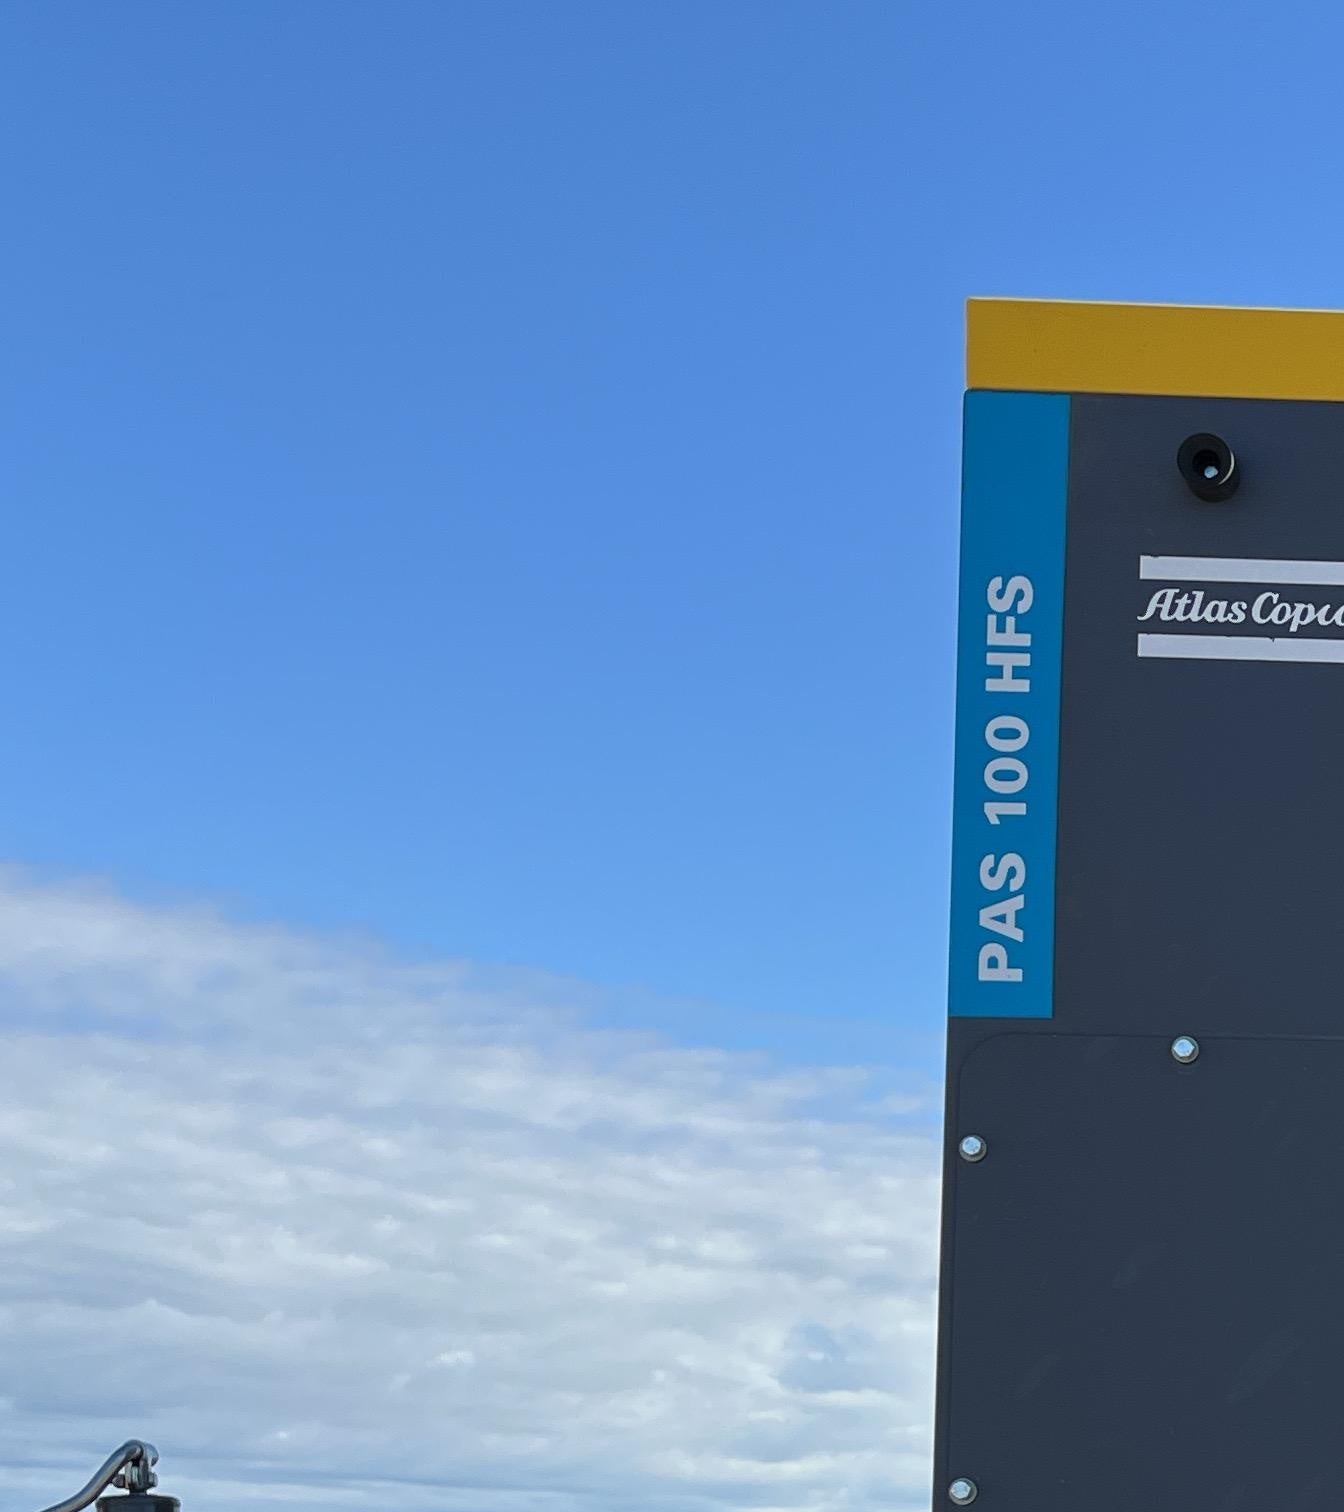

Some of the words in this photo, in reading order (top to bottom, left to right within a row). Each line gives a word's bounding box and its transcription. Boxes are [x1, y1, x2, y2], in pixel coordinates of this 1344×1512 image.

[985, 575, 1034, 693] HFS
[1137, 588, 1247, 624] Atlas
[983, 714, 1030, 825] 100
[977, 852, 1026, 982] PAS
